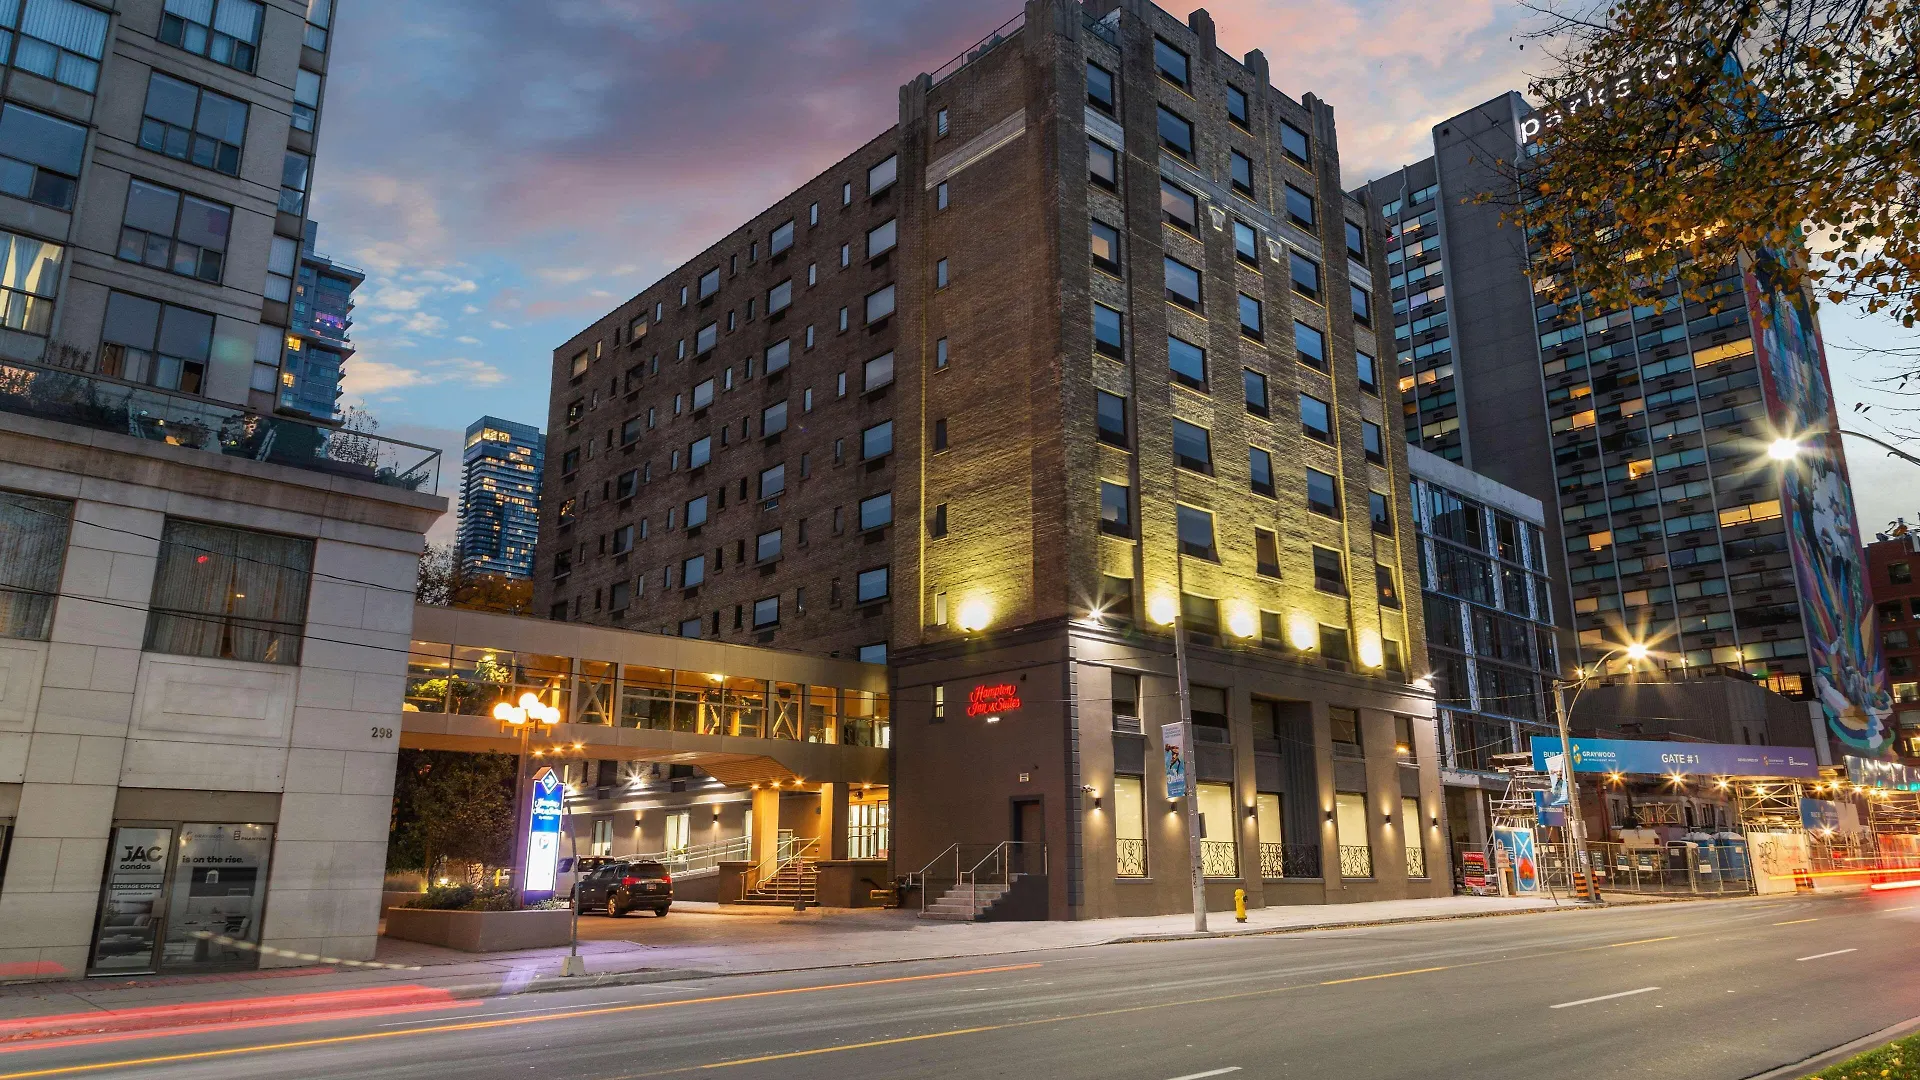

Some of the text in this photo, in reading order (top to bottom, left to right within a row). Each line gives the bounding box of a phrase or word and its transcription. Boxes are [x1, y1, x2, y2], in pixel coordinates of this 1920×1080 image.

[970, 684, 1016, 702] Hampton
[967, 700, 989, 717] Inn
[995, 697, 1021, 711] Suites
[371, 726, 393, 739] 298
[1661, 753, 1685, 764] GATE
[121, 845, 163, 863] JAC
[182, 855, 244, 864] is on the rise.
